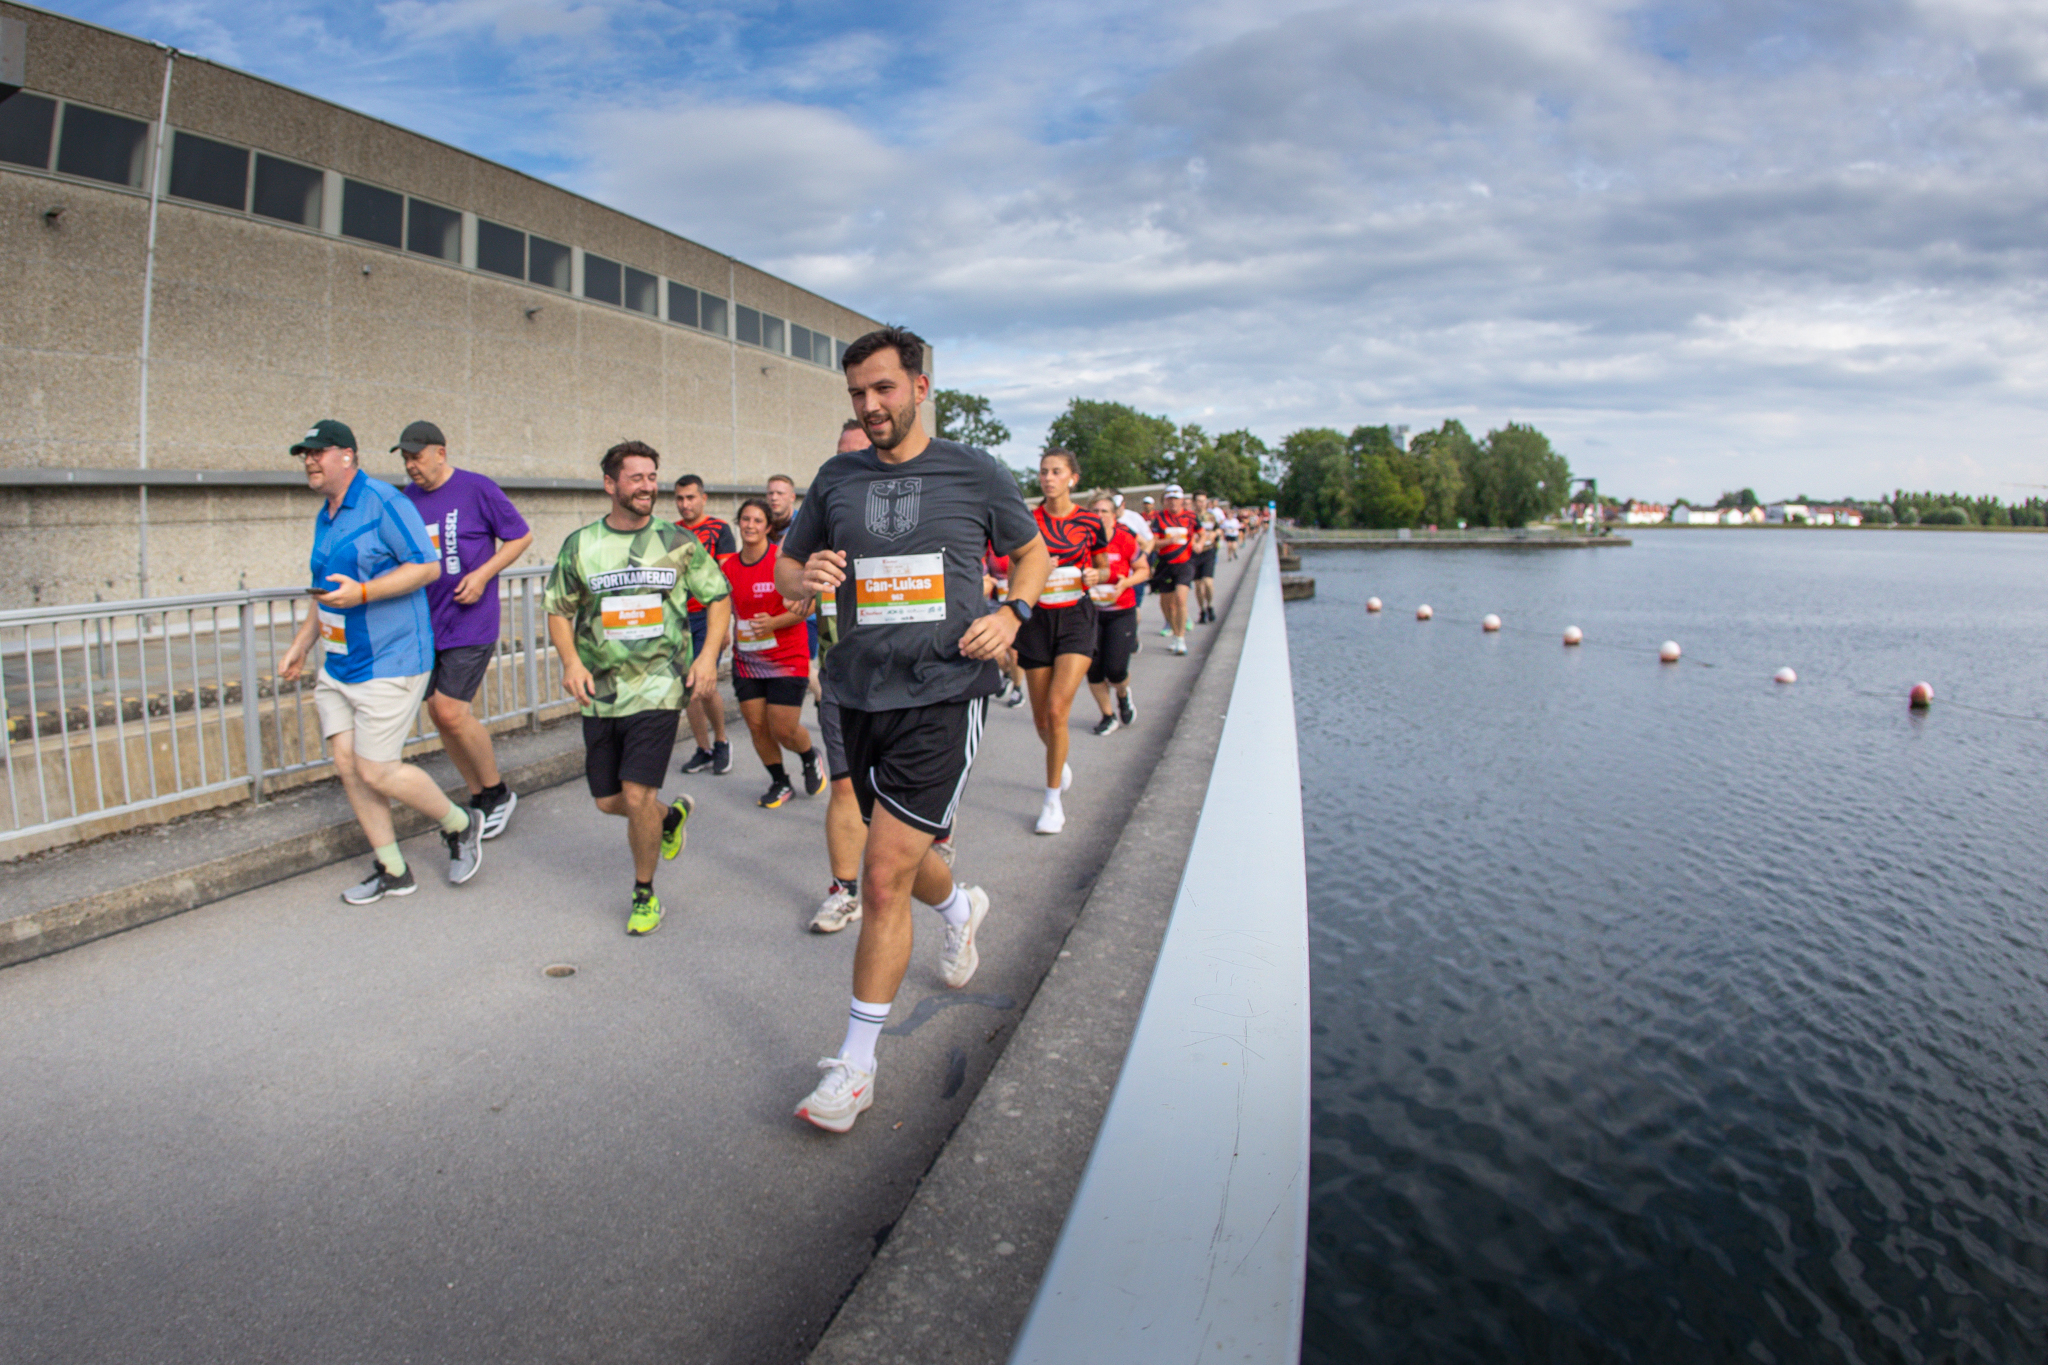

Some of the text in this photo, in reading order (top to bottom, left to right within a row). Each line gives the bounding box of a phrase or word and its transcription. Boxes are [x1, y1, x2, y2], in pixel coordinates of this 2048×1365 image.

[445, 508, 458, 554] KESSEL
[590, 570, 673, 591] SPORTKAMERAD
[865, 577, 932, 593] Can-Lukas
